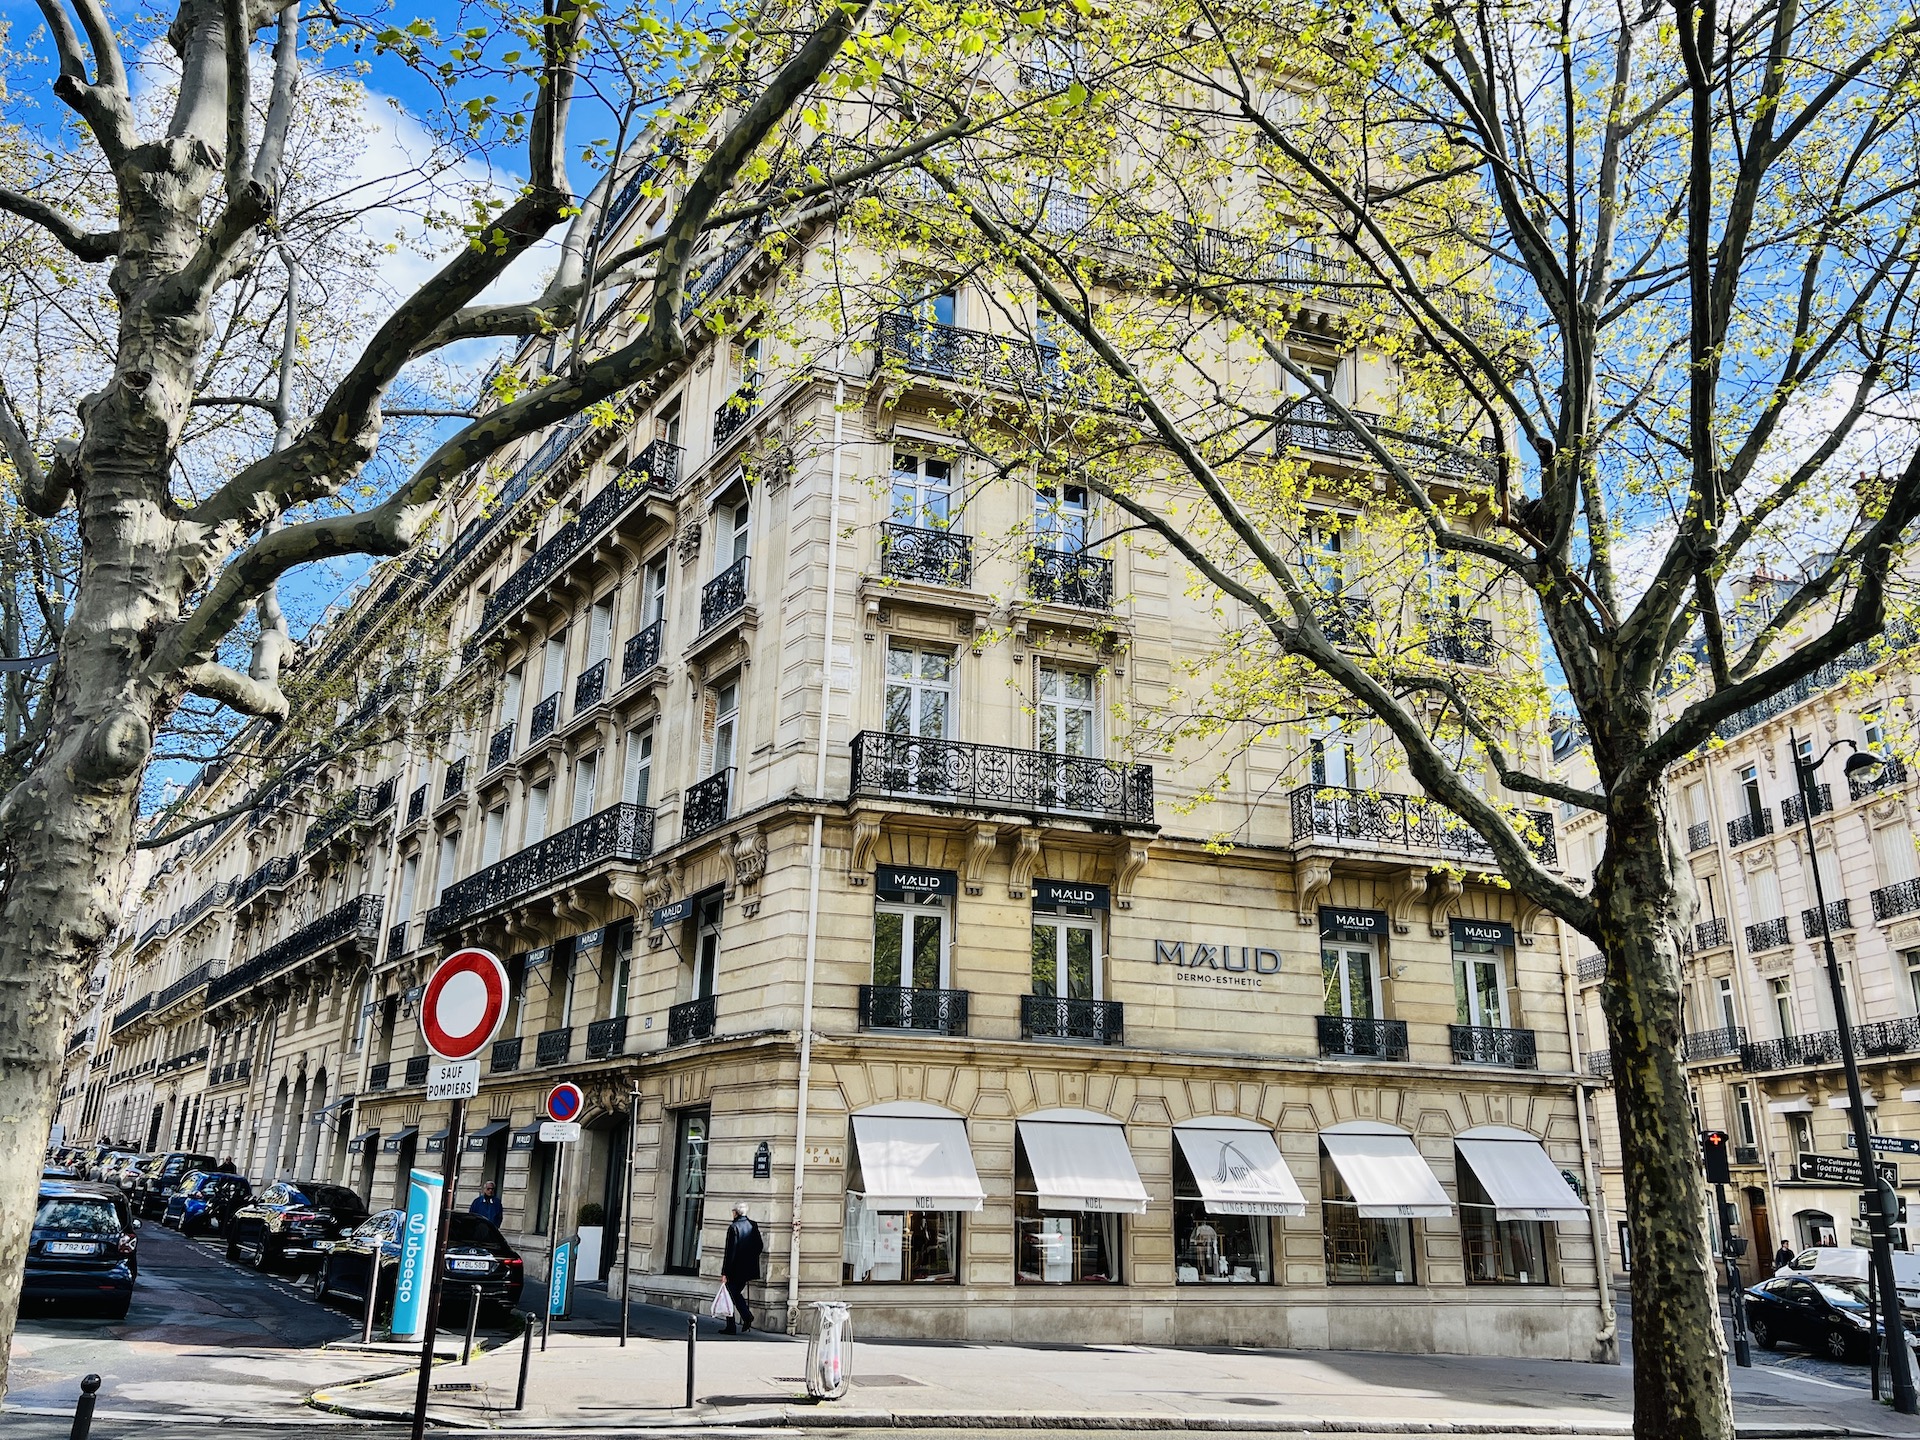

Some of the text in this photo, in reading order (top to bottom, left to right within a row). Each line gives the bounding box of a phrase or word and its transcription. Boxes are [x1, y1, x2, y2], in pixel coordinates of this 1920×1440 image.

[894, 874, 940, 888] MAUD
[1051, 888, 1094, 901] MAUD
[661, 904, 683, 919] MAUD
[1336, 915, 1375, 927] MAUD
[581, 932, 598, 945] MAUD
[1465, 926, 1502, 939] MAUD
[1155, 939, 1282, 974] MAUD
[1177, 973, 1262, 986] DERMO-ESTHETIC
[441, 1066, 463, 1080] SAUF
[428, 1081, 472, 1097] POMPIERS
[1828, 1158, 1852, 1167] Culturel
[1222, 1202, 1289, 1215] LINGE DE MAISON
[399, 1236, 421, 1303] ubeeqo
[551, 1266, 564, 1305] ubeeqo
